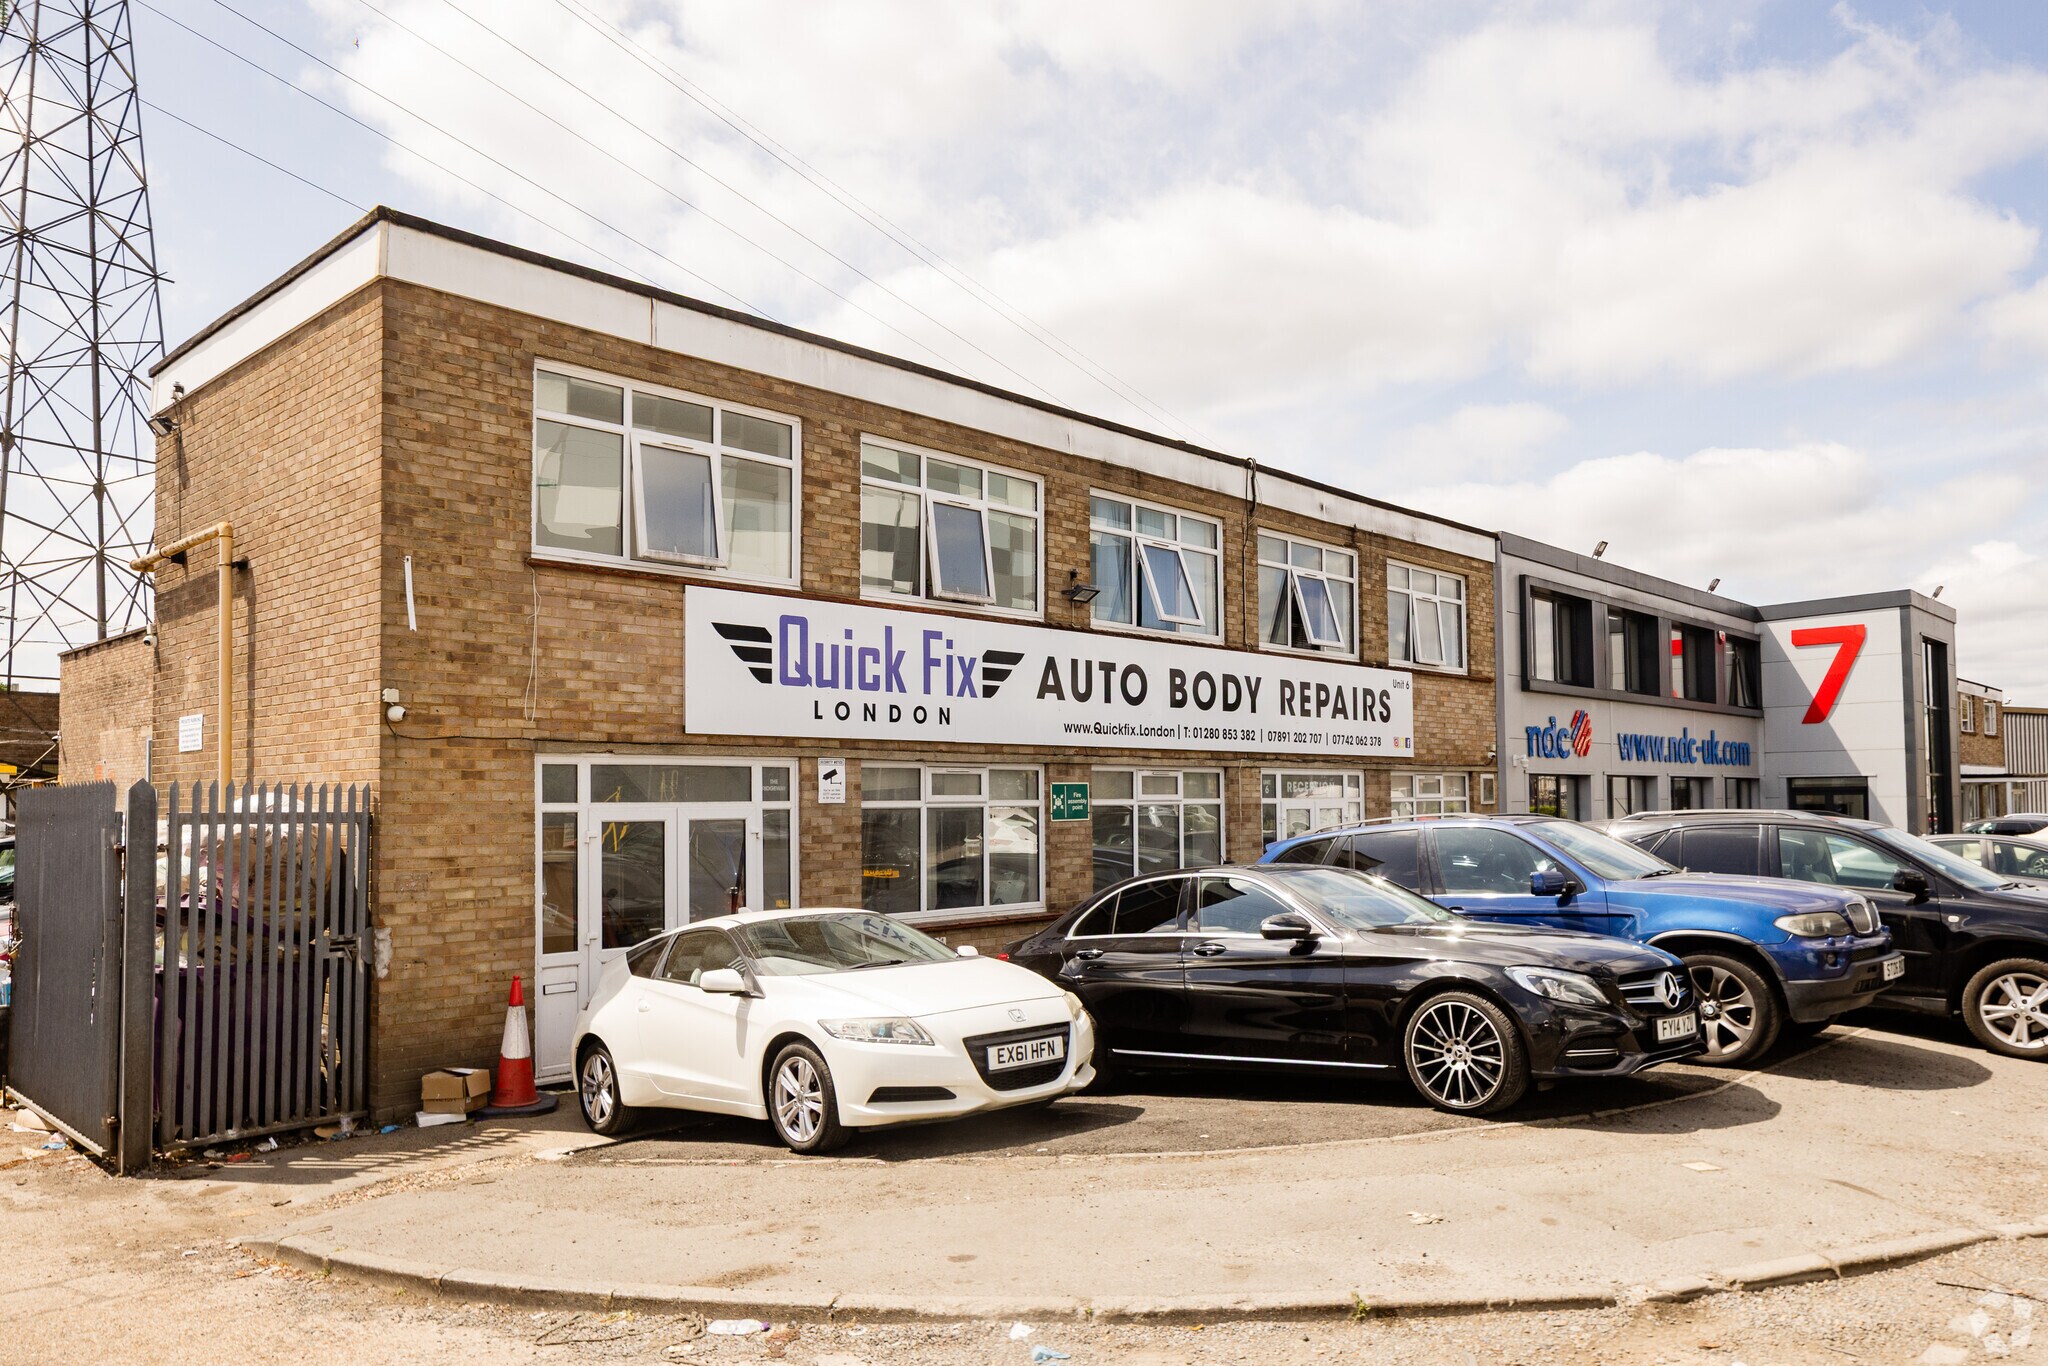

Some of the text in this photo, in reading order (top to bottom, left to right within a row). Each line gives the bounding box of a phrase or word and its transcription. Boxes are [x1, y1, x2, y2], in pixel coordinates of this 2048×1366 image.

[779, 614, 979, 699] Quick Fix
[1392, 678, 1410, 690] Unit 6
[1791, 624, 1866, 724] 7
[1036, 655, 1391, 724] AUTO BODY REPAIRS
[814, 700, 951, 726] LONDON
[1063, 721, 1382, 747] www.Quickfix.London T: 01280 853 382 07891 202 707 07742 062 378
[1526, 716, 1571, 759] ndc
[1618, 727, 1751, 766] www.ndc-uk.com
[1264, 785, 1270, 794] 6
[1287, 781, 1335, 793] RECEPTION
[1661, 1018, 1681, 1037] FY14
[997, 1040, 1056, 1065] EX61 HFN
